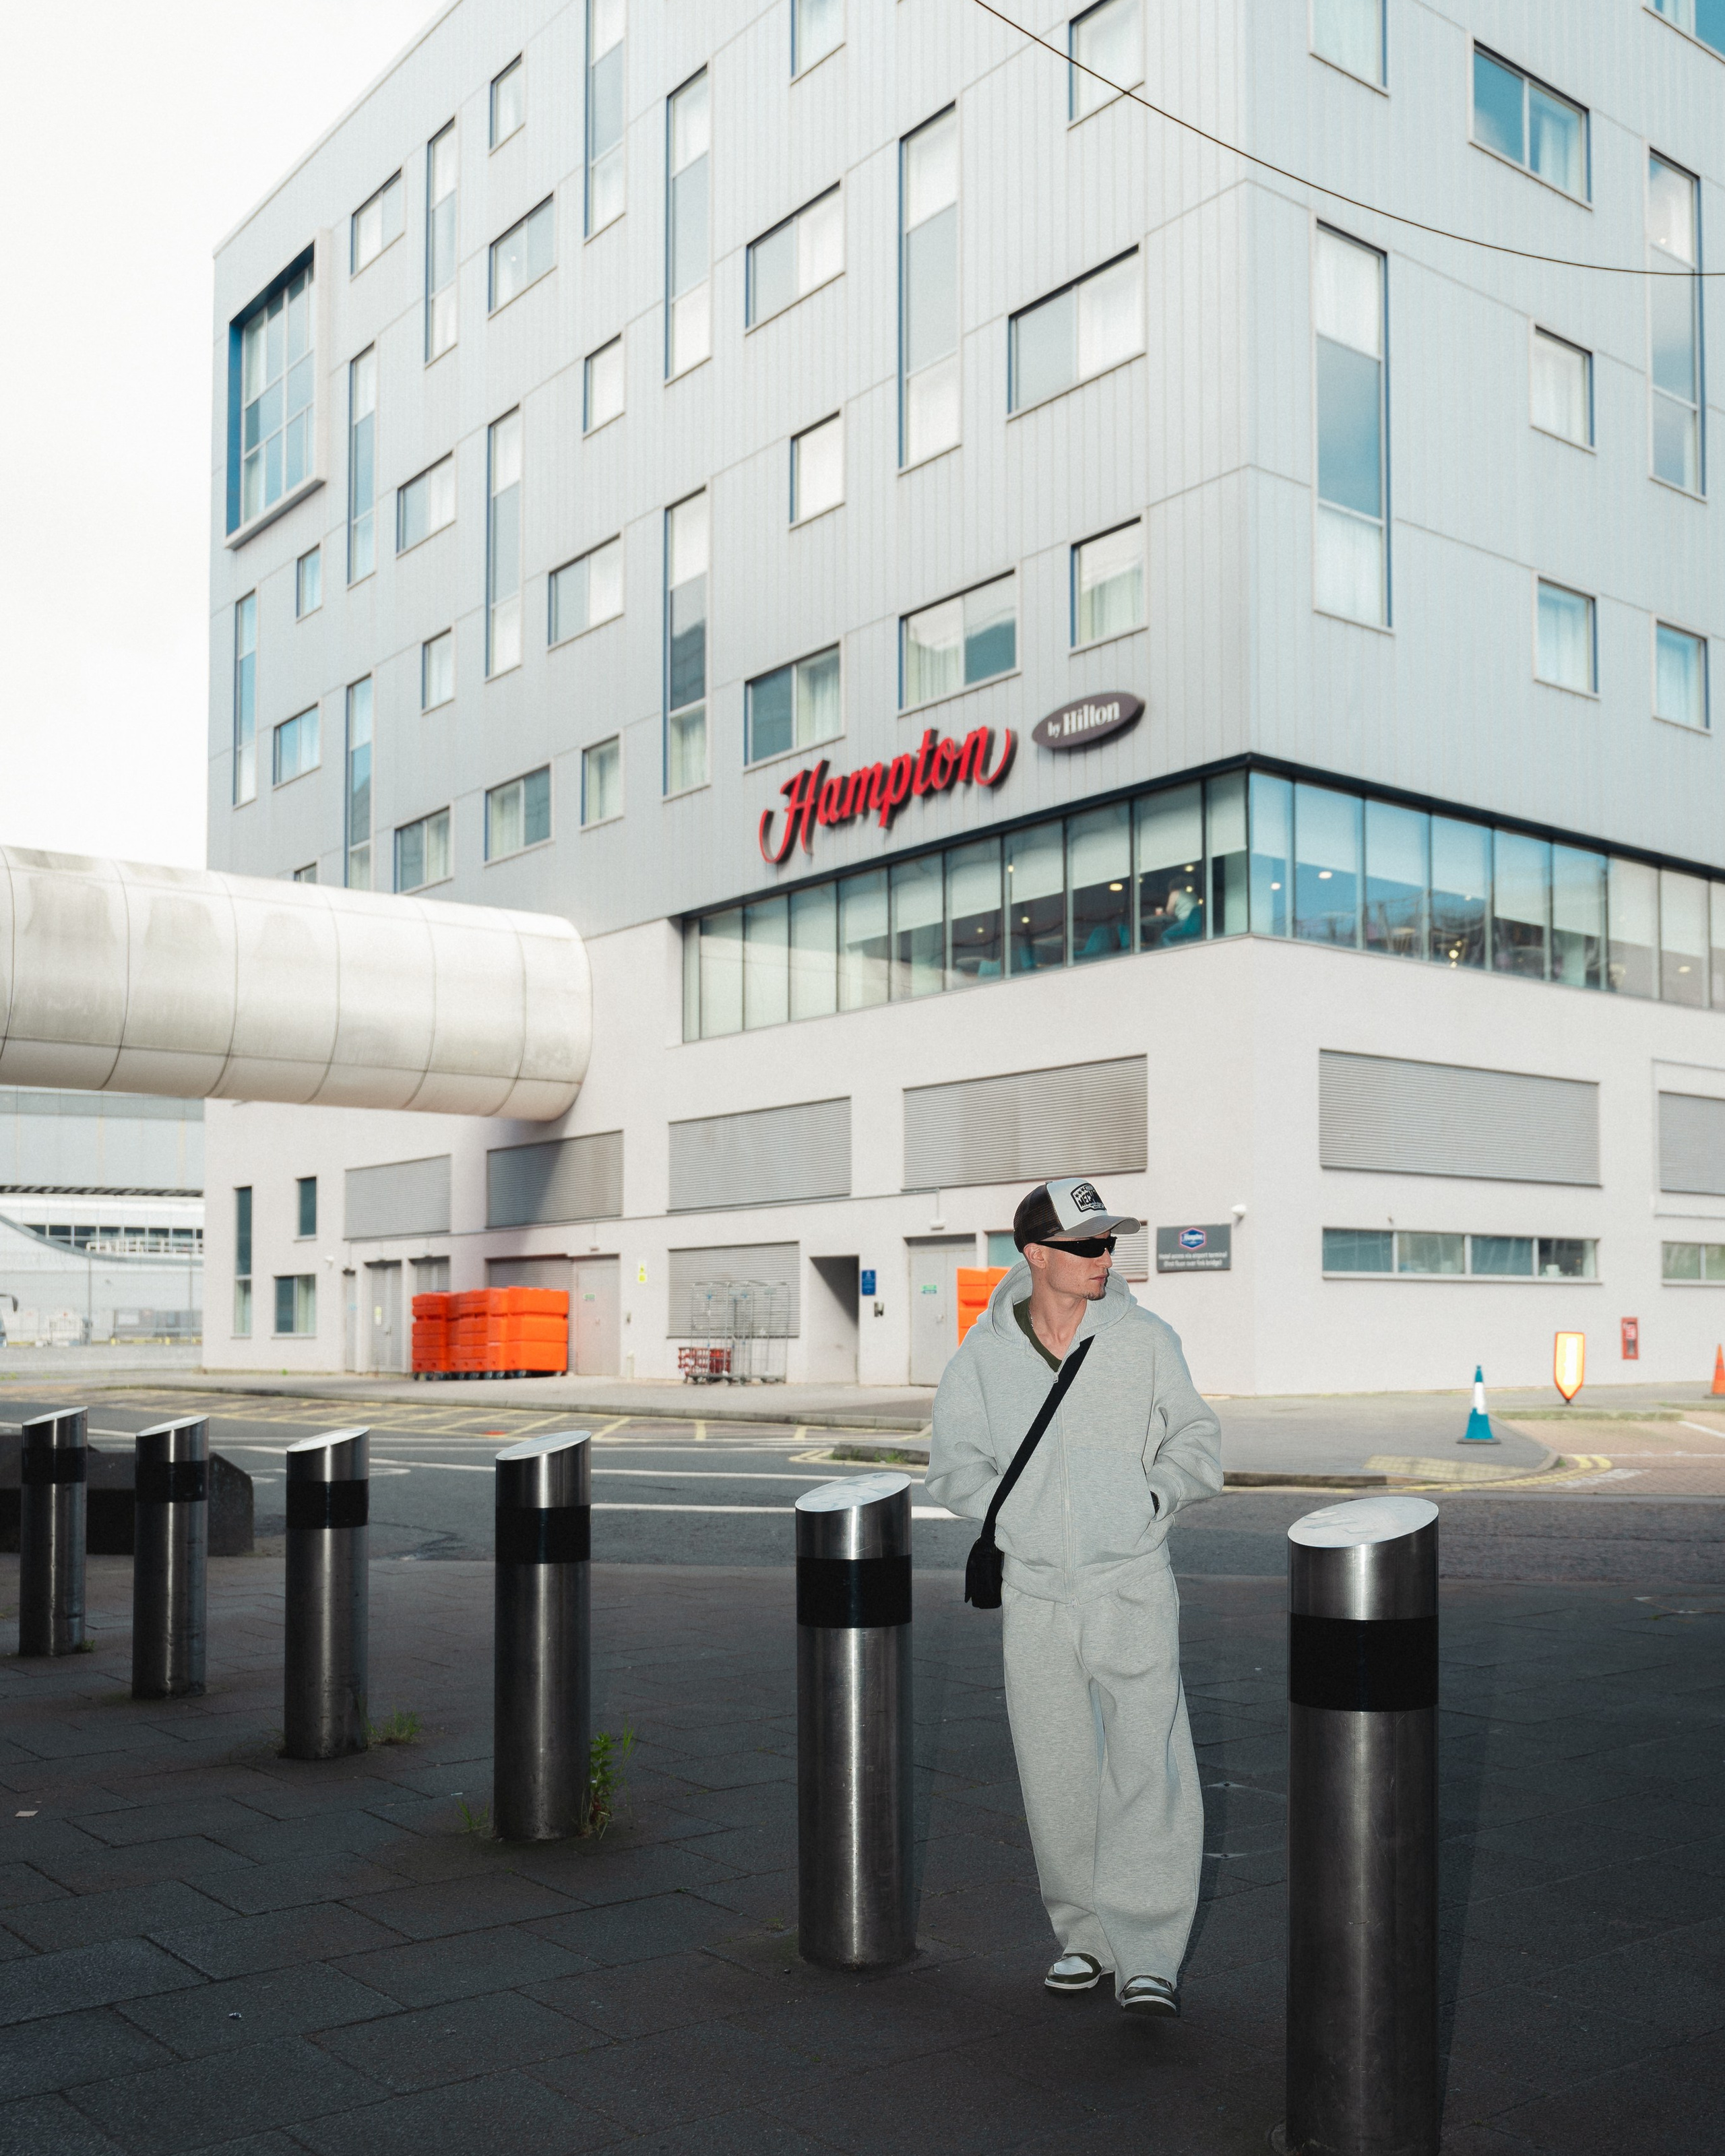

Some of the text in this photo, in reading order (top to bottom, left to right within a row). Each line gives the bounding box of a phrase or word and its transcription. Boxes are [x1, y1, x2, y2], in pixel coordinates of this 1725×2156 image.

[1047, 701, 1120, 738] by Hilton
[759, 724, 1013, 864] Hampton
